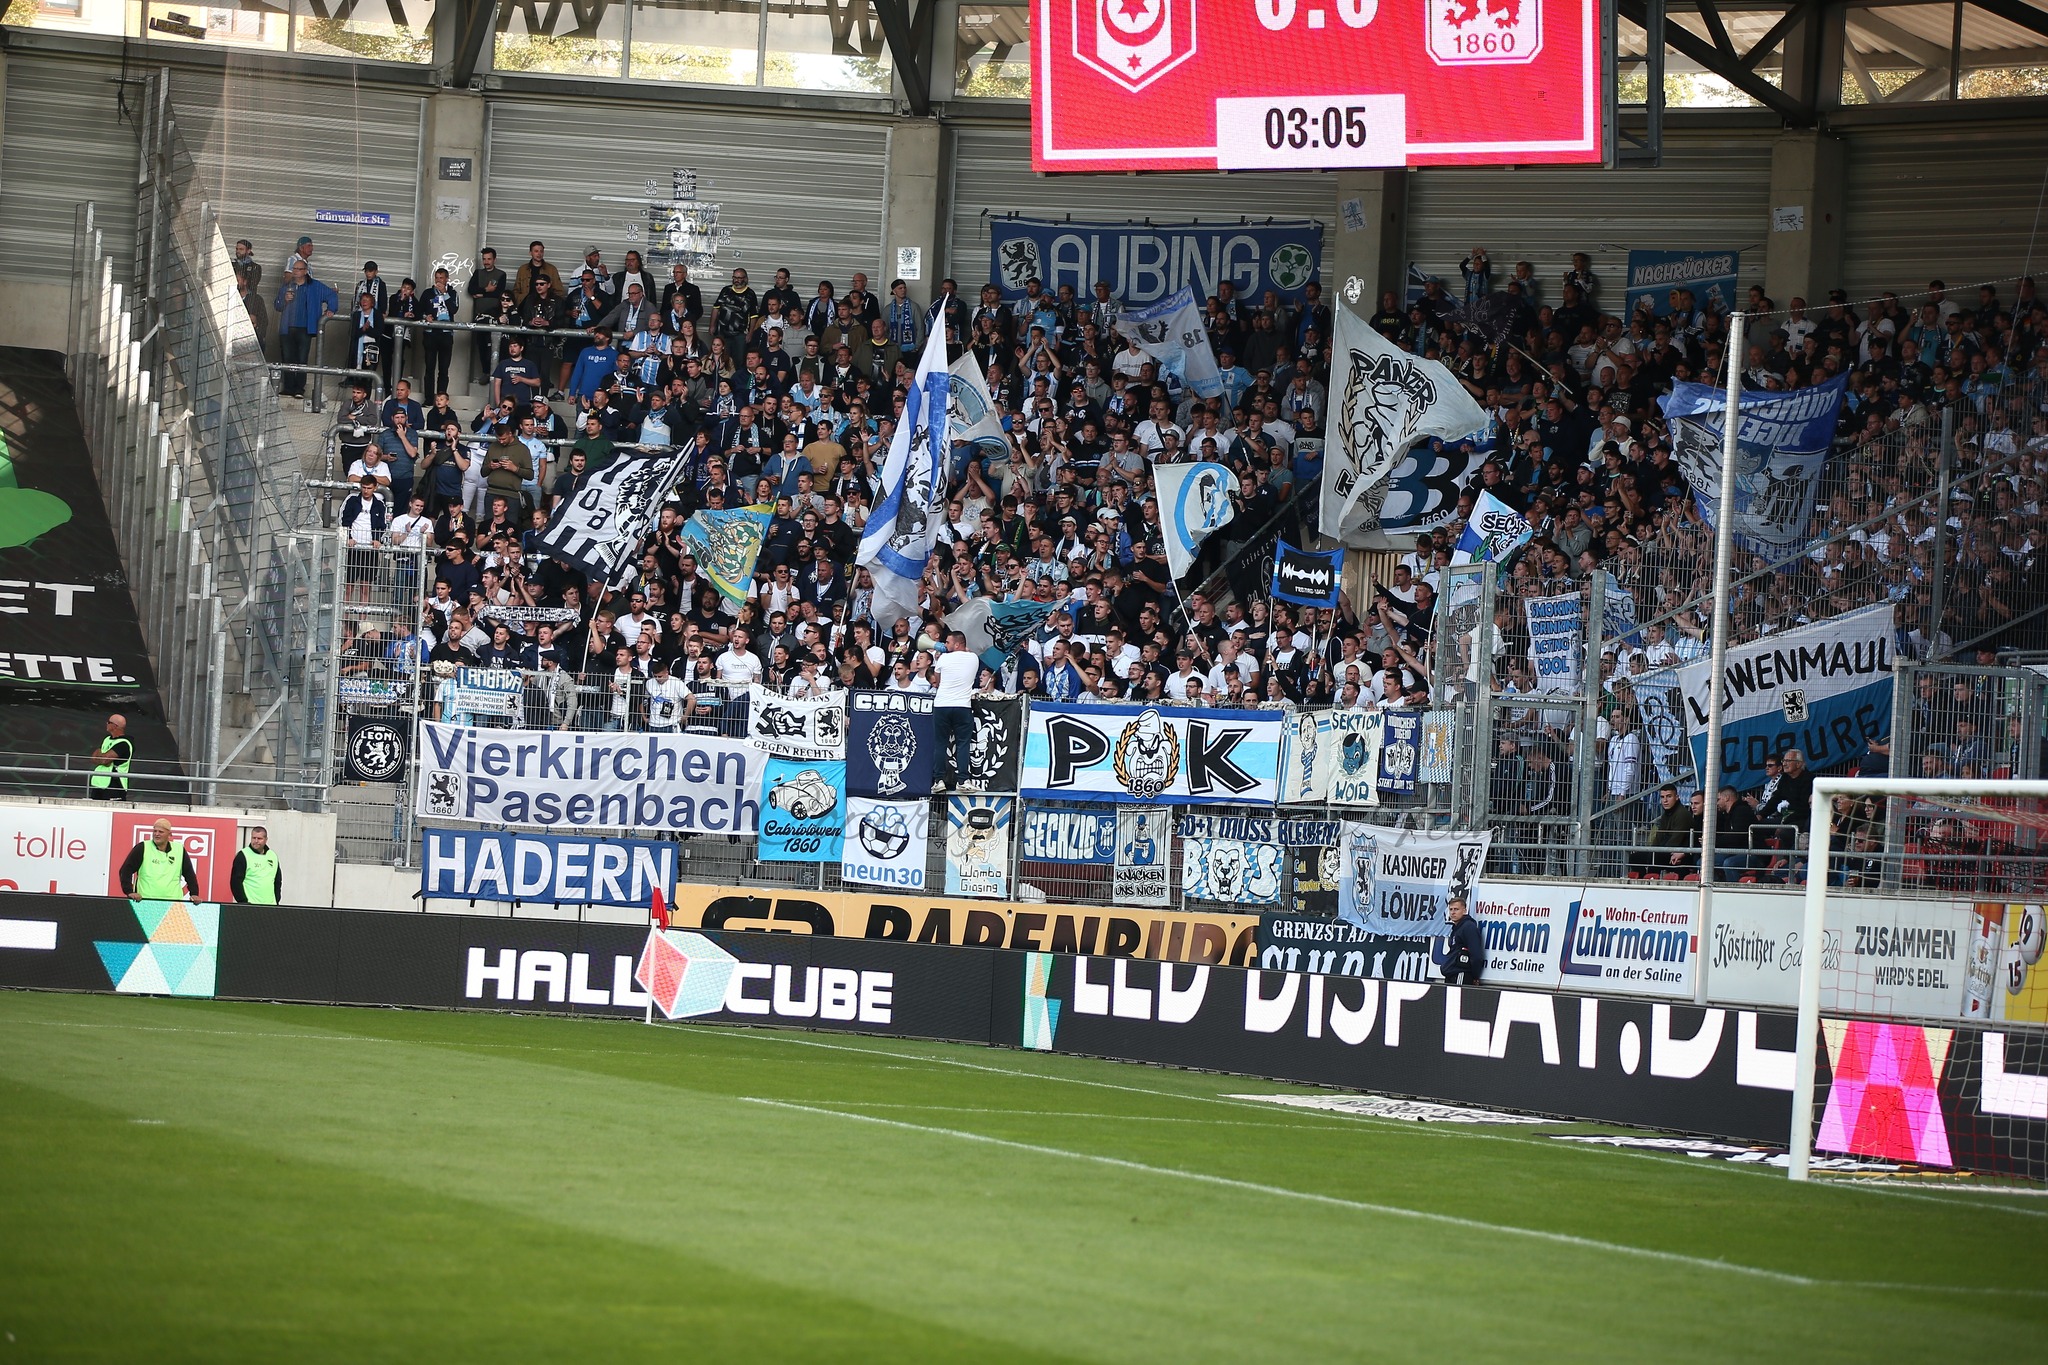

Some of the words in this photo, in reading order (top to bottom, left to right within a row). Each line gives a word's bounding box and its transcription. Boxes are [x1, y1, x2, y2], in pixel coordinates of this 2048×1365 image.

[1453, 32, 1516, 54] 1860
[1265, 107, 1366, 149] 03:05
[316, 211, 369, 223] Grünwalder
[371, 213, 387, 224] Str.
[1050, 233, 1260, 300] AUBING
[1633, 255, 1732, 285] NACHRÜCKER
[1014, 279, 1030, 289] 186
[1351, 349, 1438, 414] PANZER
[1420, 511, 1449, 526] 1860
[1481, 512, 1532, 535] SECHZ
[1530, 599, 1582, 618] SMOKING
[1531, 617, 1582, 636] DRINKING
[1535, 637, 1569, 654] ACTING
[1538, 656, 1569, 676] COOL
[459, 668, 523, 692] LAMBADA
[1687, 637, 1893, 725] LWENMAUL
[458, 702, 504, 711] LÖWEN-POWER
[475, 695, 504, 704] MÜNCHEN
[1331, 713, 1382, 731] SEKTION
[361, 730, 396, 741] LEONI
[425, 725, 746, 787] Vierkirchen
[753, 740, 790, 754] GEGEN
[792, 749, 834, 759] RECHTS
[1127, 779, 1165, 793] 1860
[1335, 781, 1369, 801] WOID
[432, 806, 452, 815] 1860
[466, 776, 759, 832] Pasenbach
[764, 820, 842, 837] Cabriolöwen
[1024, 811, 1095, 860] SECHZIG
[1219, 817, 1271, 843] MUSS
[14, 827, 86, 859] tolle
[783, 838, 821, 853] 1860
[427, 835, 673, 903] HADERN
[843, 863, 923, 886] neun30
[1115, 868, 1165, 881] KNACKEN
[1382, 853, 1447, 879] KASINGER
[1115, 885, 1134, 897] UNS
[1136, 885, 1167, 898] NICHT
[1475, 901, 1550, 918] Wohn-Centrum
[1605, 906, 1688, 925] Wohn-Centrum
[1560, 900, 1688, 977] Lührmann
[1713, 924, 1775, 970] Köstritzer
[1855, 925, 1956, 961] ZUSAMMEN
[1490, 959, 1508, 970] der
[1510, 959, 1545, 973] Saline
[1605, 968, 1622, 978] an
[1623, 967, 1642, 980] der
[1643, 967, 1683, 983] Saline
[1875, 966, 1914, 987] WIRD'S
[1917, 968, 1949, 990] EDEL.
[725, 962, 894, 1024] CUBE
